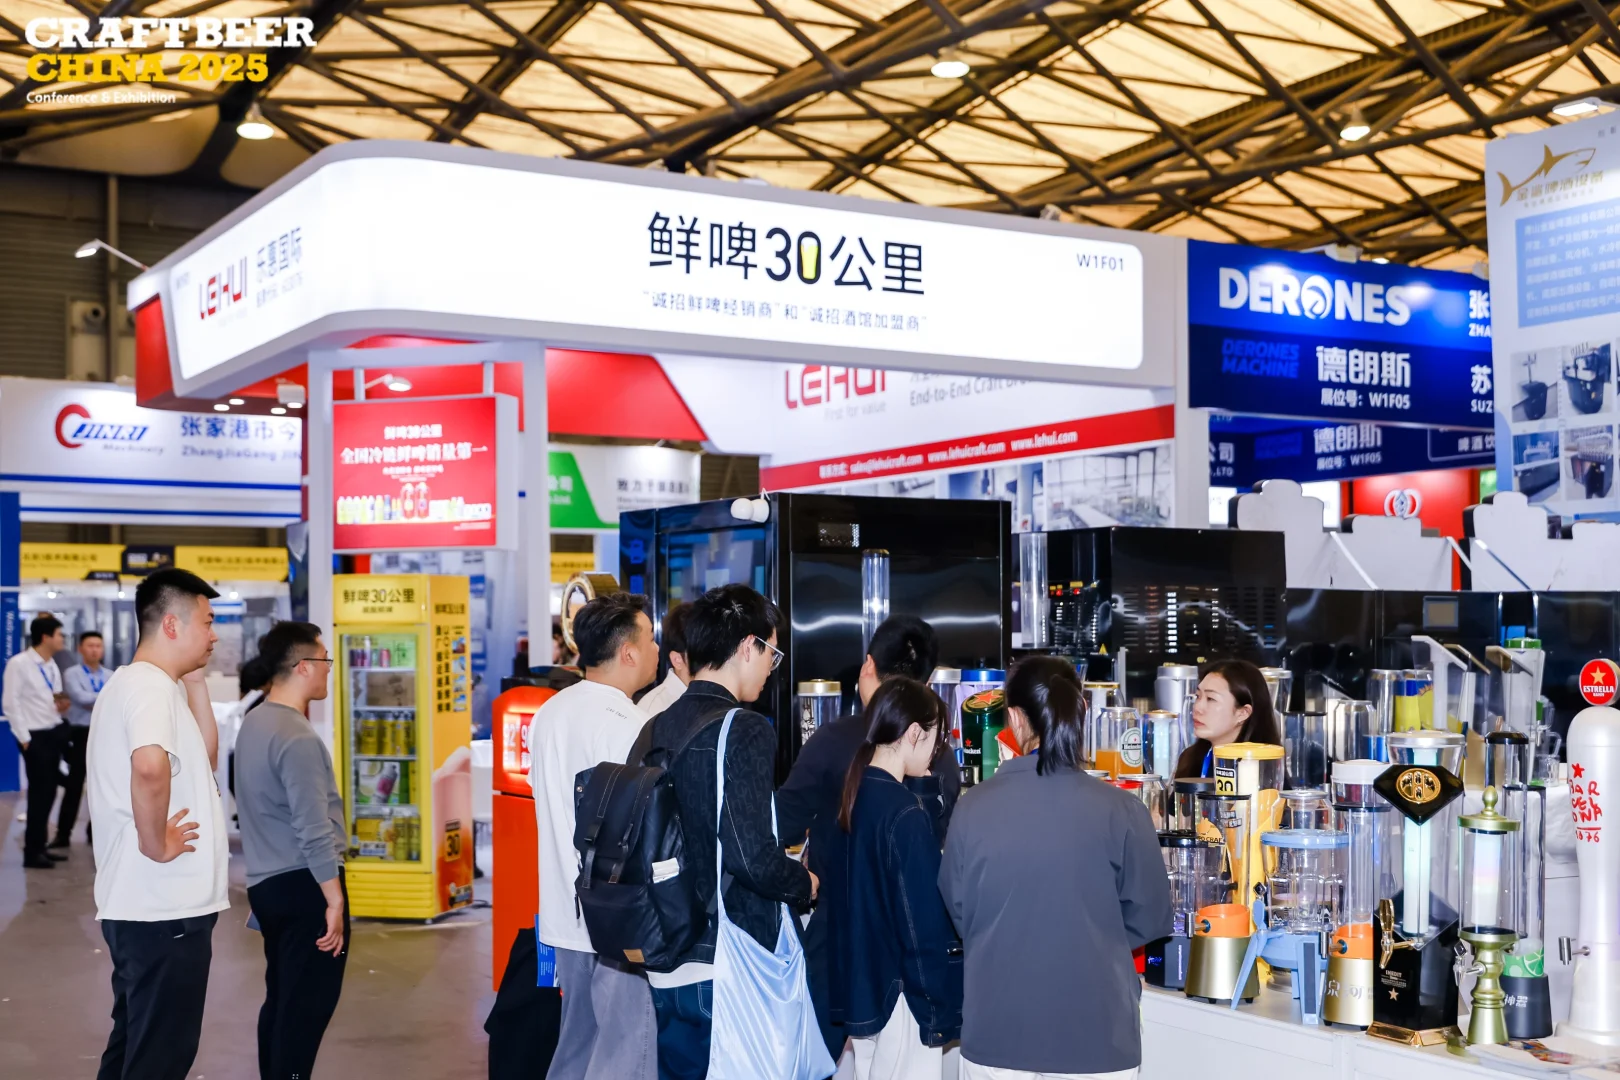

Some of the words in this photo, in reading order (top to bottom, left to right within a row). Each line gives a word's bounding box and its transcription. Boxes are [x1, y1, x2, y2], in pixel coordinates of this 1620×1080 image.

[648, 211, 925, 296] 鲜啤30公里
[1076, 252, 1125, 272] W1F01
[1218, 266, 1412, 327] DERONES
[1222, 338, 1299, 361] DERONES
[1222, 356, 1299, 379] MACHINE
[1316, 345, 1411, 388] 德朗斯
[1470, 364, 1492, 395] 苏
[909, 384, 971, 407] End-to-End
[1368, 391, 1411, 410] W1F05
[1010, 430, 1078, 452] www.lehui.com
[343, 588, 416, 605] 鲜啤30公里
[1583, 685, 1615, 693] ESTRELLA
